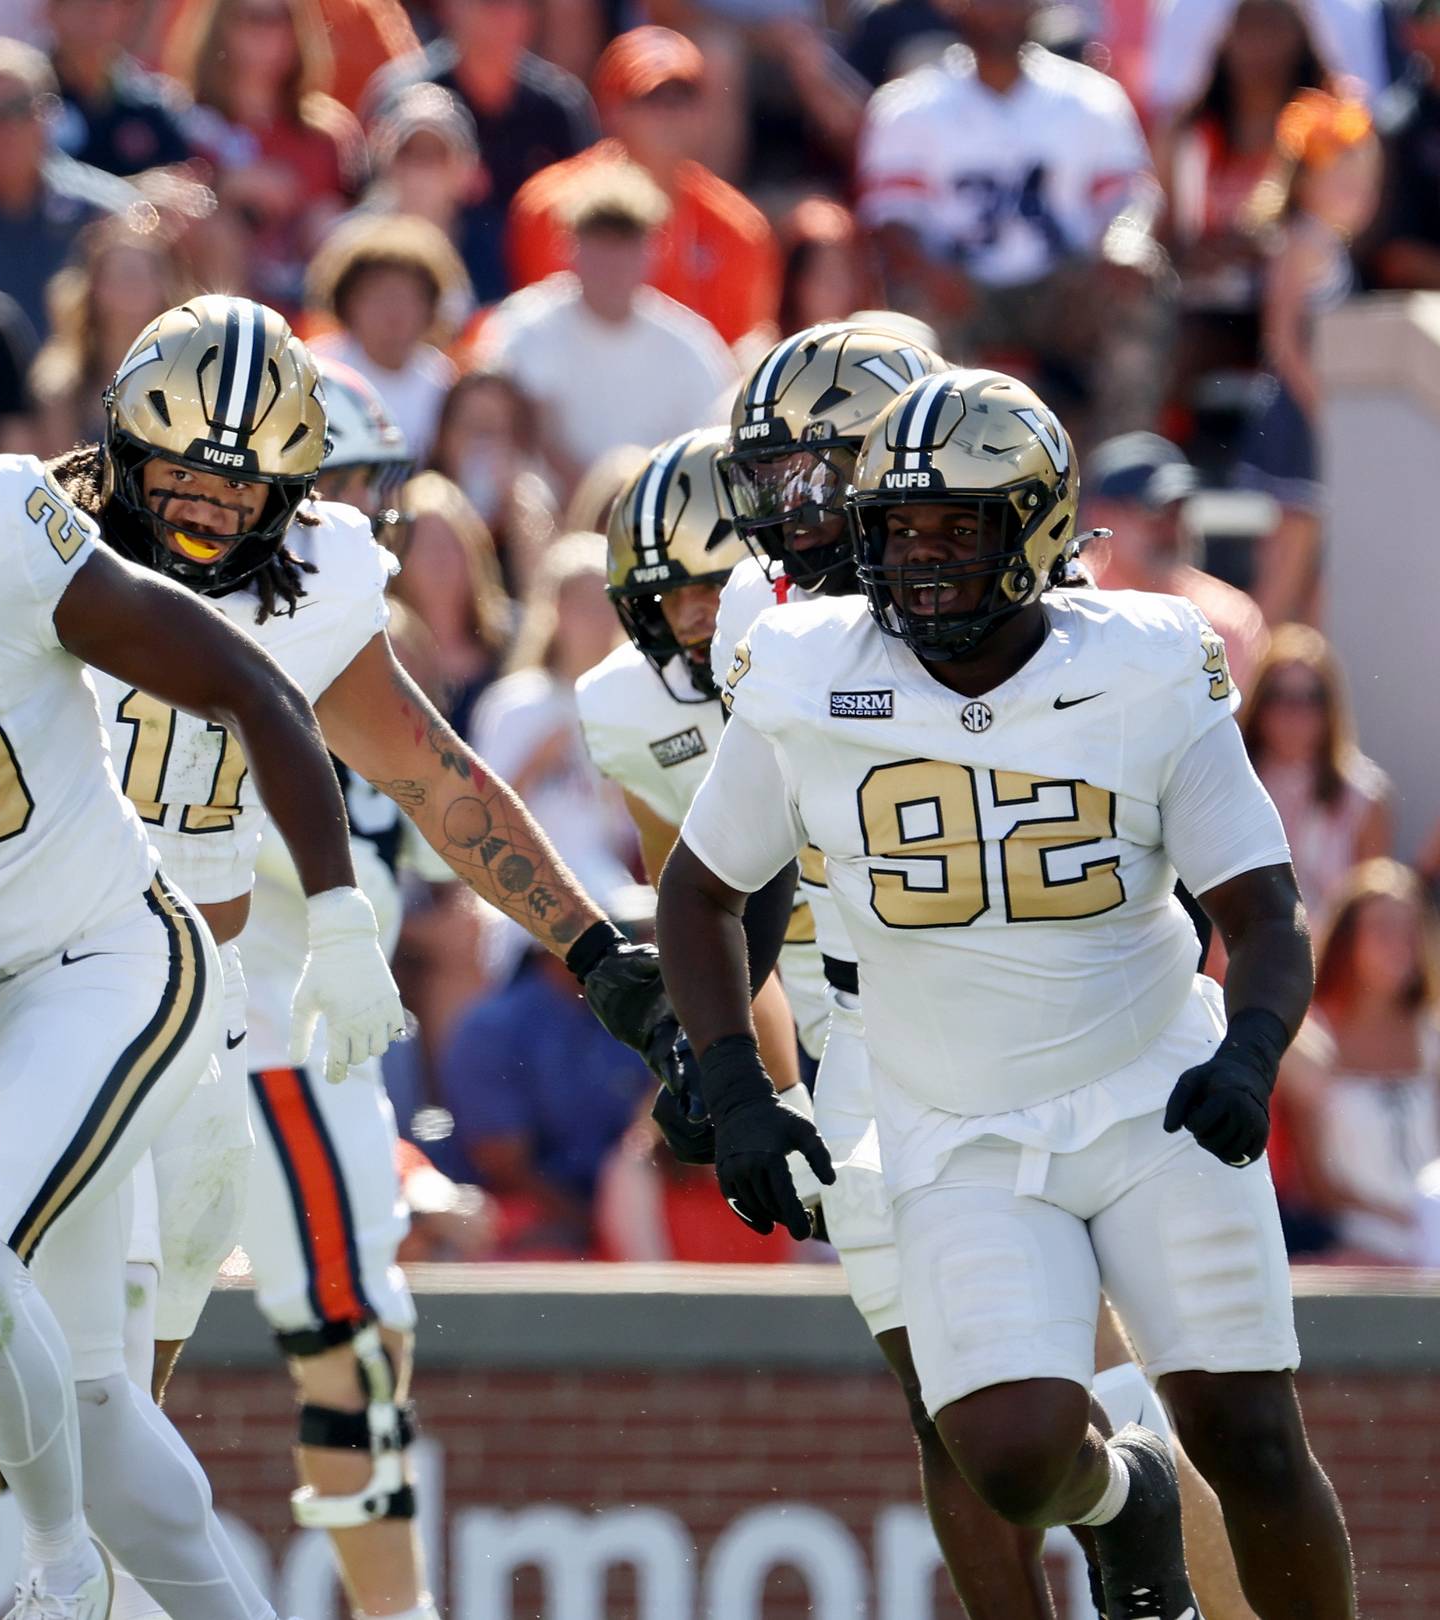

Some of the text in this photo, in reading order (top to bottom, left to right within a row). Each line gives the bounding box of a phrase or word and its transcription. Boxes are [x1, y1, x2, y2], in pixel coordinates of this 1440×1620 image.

[739, 423, 771, 441] VUFB
[1009, 407, 1071, 477] V
[202, 446, 246, 467] VUFB
[885, 472, 932, 489] VUFB
[25, 478, 90, 565] 2
[633, 565, 670, 583] VUFB
[842, 693, 892, 710] SRM
[962, 702, 992, 732] SEC
[116, 689, 248, 834] 11
[857, 757, 1127, 930] 92
